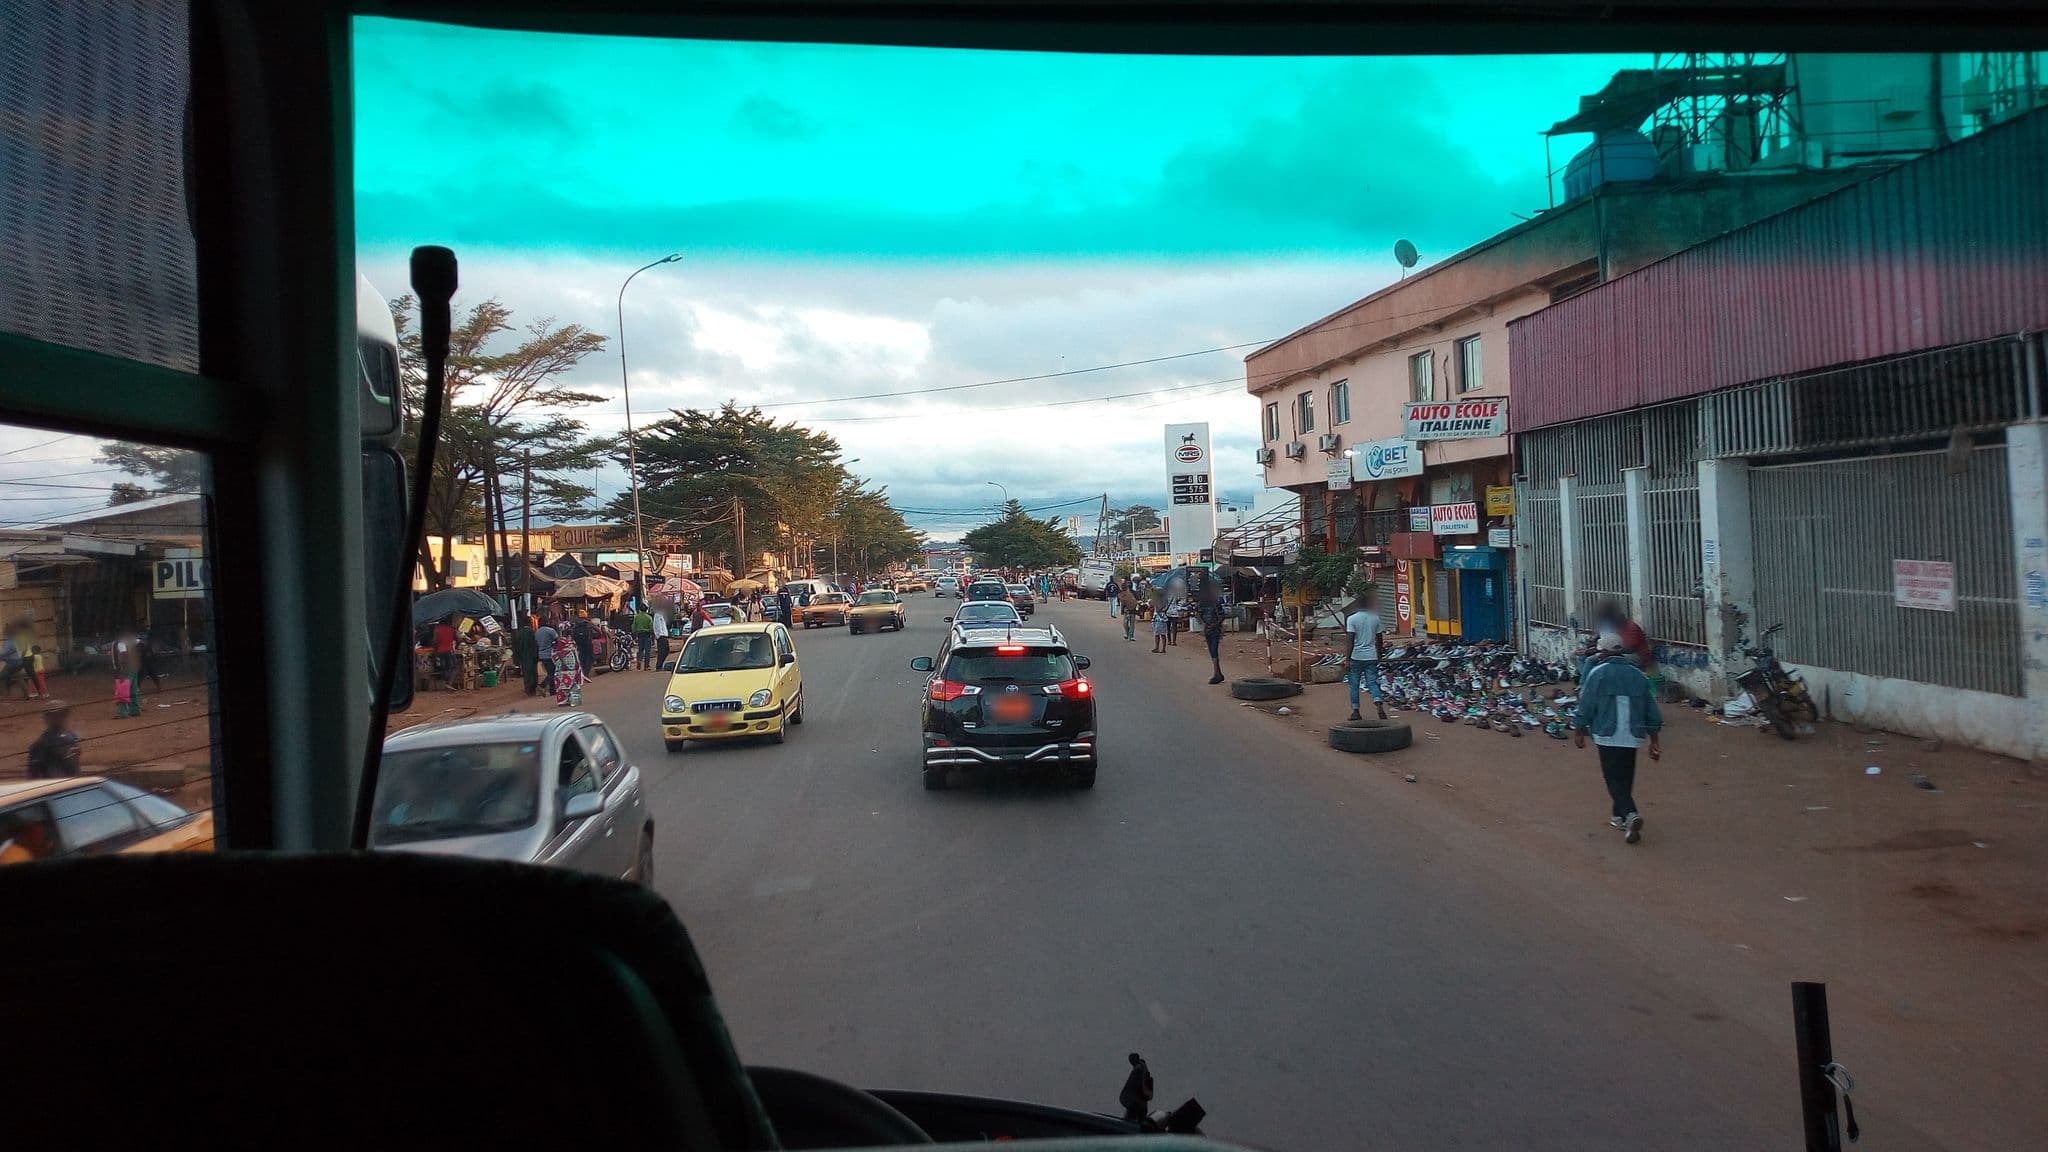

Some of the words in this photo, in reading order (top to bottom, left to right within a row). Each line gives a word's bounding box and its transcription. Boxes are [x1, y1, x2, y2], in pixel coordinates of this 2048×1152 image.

[1410, 405, 1450, 420] AUTO
[1455, 403, 1498, 418] ECOLE
[1419, 419, 1491, 432] ITALIENNE
[1385, 446, 1408, 461] BET
[1188, 485, 1204, 493] 575
[1189, 495, 1204, 503] 350
[1433, 507, 1452, 522] AUTO
[1455, 504, 1476, 520] ECOLE
